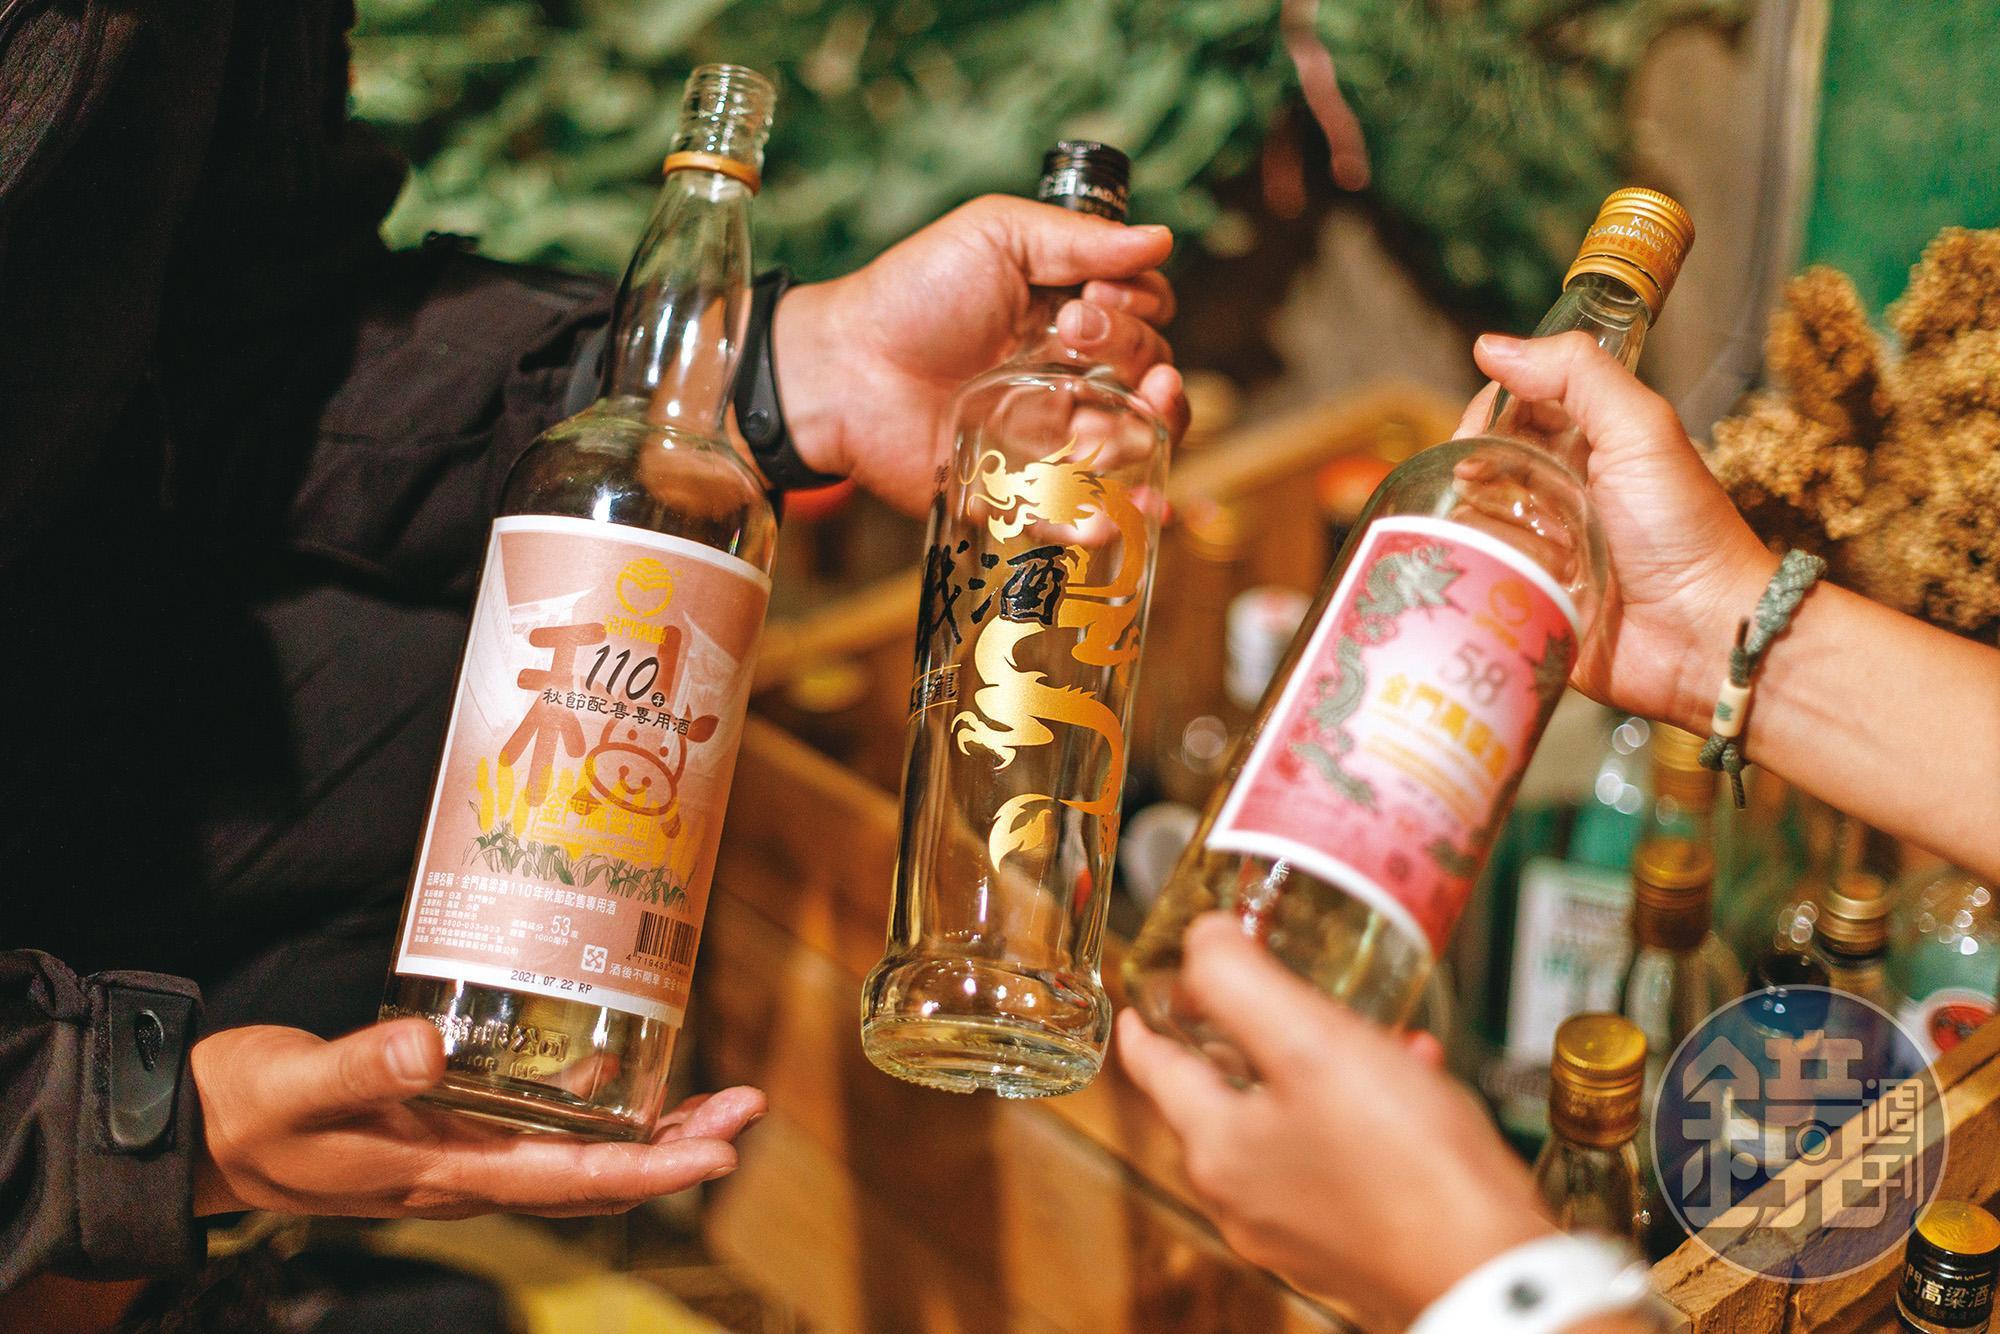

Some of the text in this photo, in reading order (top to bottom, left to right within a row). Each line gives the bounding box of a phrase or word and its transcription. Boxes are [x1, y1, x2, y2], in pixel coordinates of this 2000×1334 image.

[1439, 641, 1511, 706] 58
[541, 686, 692, 737] 秋節配售專用酒
[510, 969, 593, 995] 2021.07.22 RP
